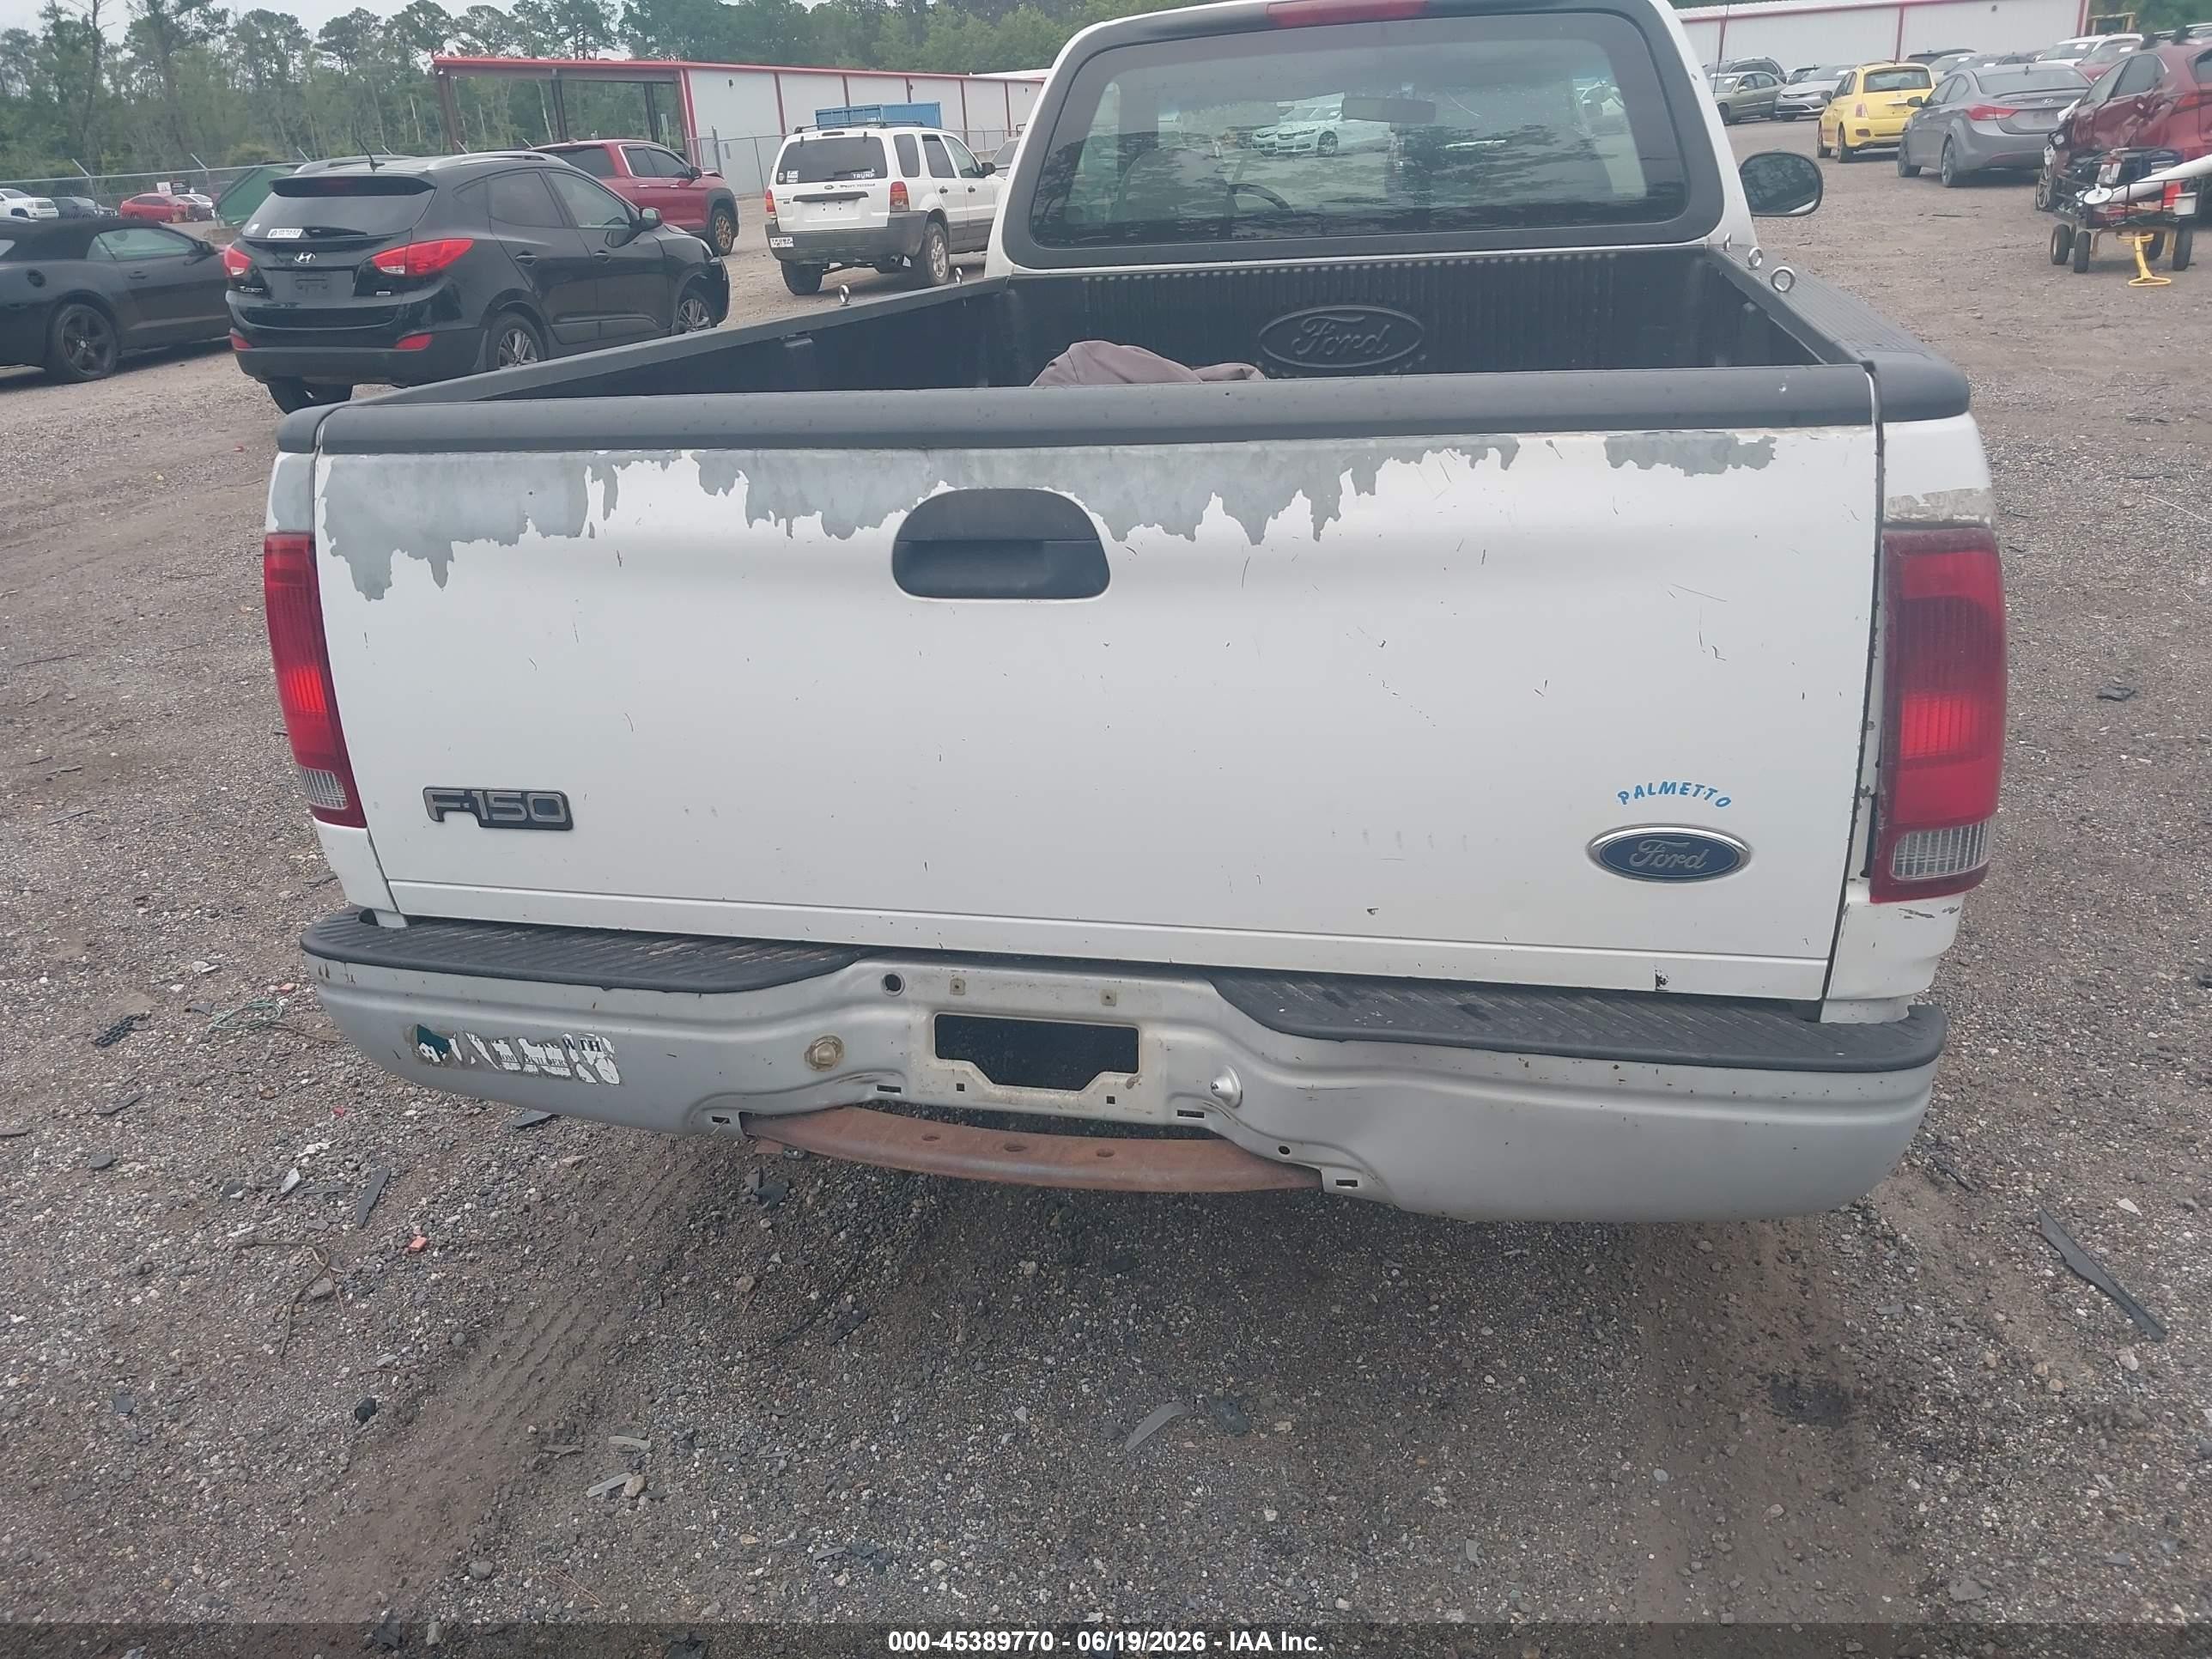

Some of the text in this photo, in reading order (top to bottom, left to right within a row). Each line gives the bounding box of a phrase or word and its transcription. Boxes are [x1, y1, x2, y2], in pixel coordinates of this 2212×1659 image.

[1291, 316, 1390, 356] Ford
[1617, 781, 1731, 808] PALMETTO
[1629, 839, 1710, 869] Ford
